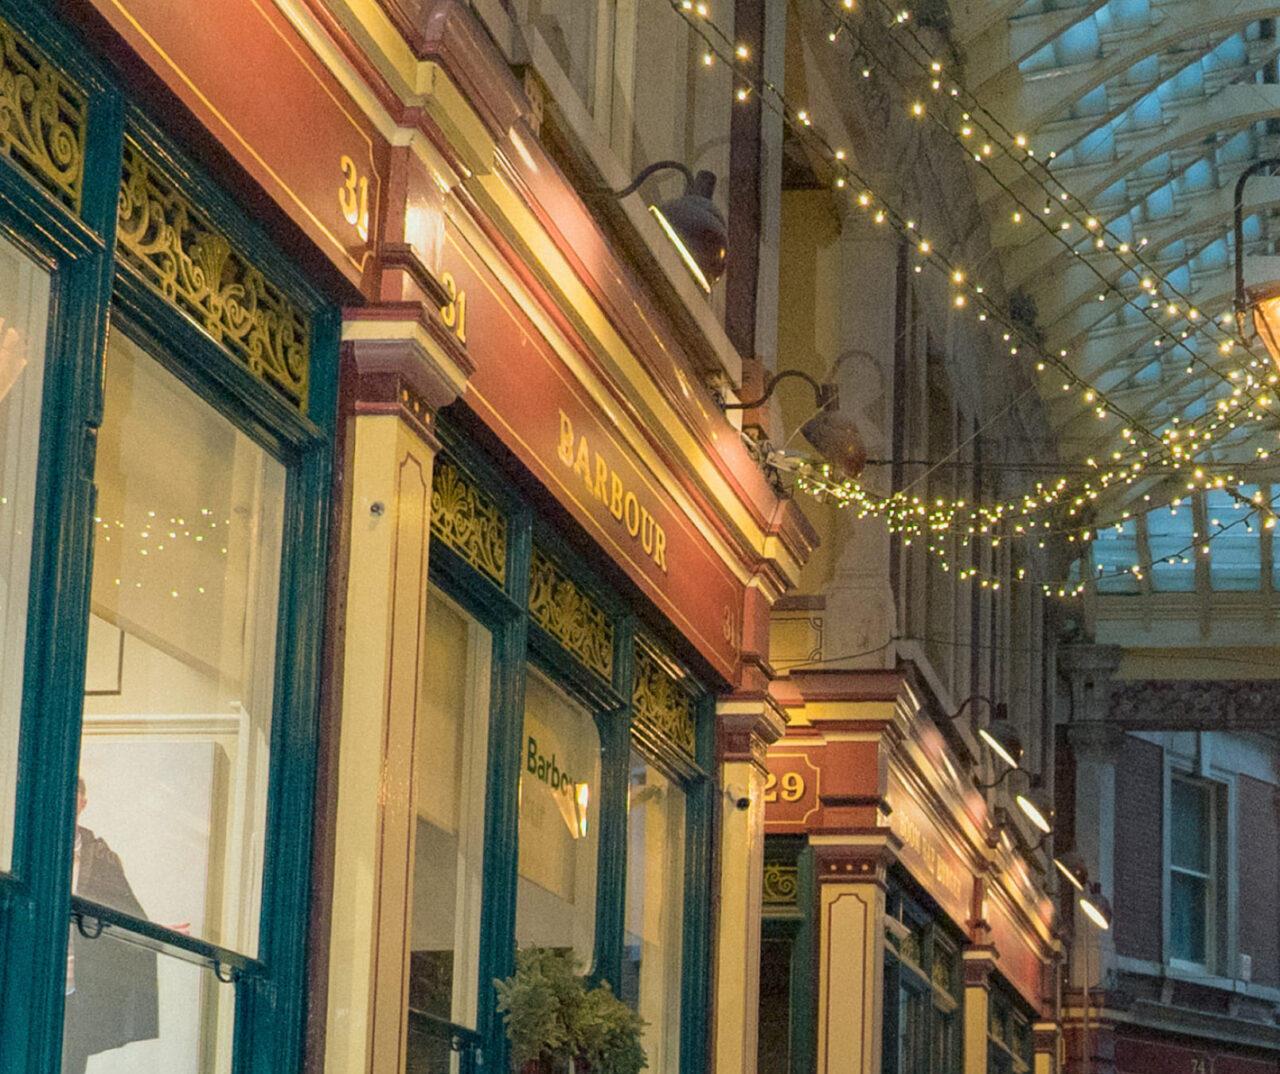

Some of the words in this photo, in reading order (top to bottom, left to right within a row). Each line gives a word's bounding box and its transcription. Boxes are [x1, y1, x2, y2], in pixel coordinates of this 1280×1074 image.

[339, 155, 369, 242] 31
[441, 272, 466, 343] 31
[558, 408, 668, 573] BARBOUR
[723, 604, 737, 648] 31
[763, 771, 806, 804] 29
